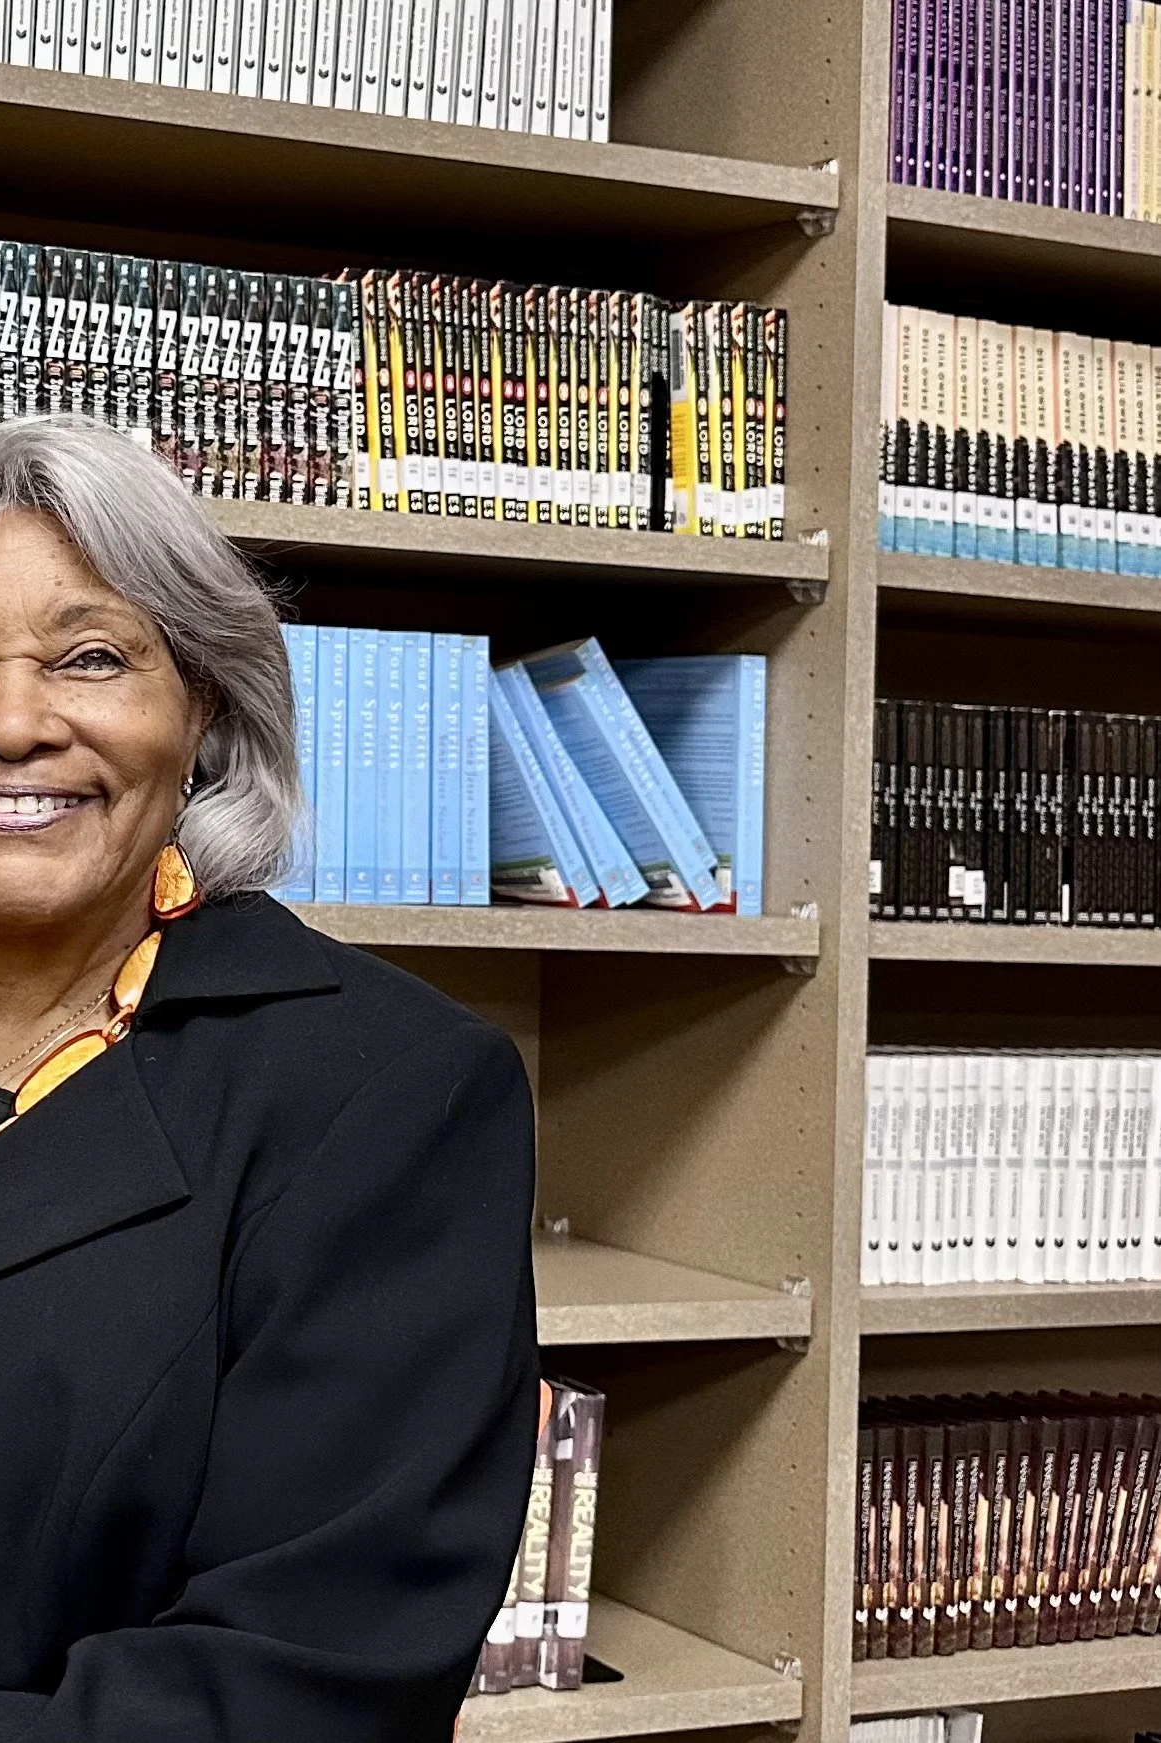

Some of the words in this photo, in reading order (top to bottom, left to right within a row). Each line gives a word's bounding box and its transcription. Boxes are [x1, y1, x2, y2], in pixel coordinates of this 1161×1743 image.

[333, 332, 351, 390] Z
[380, 393, 392, 436] LORD
[406, 394, 419, 438] LORD
[423, 397, 436, 440] LORD
[445, 398, 457, 442] LORD
[462, 401, 474, 444] LORD
[558, 406, 569, 450] LORD
[773, 426, 784, 468] LORD
[303, 640, 315, 685] Four
[333, 644, 347, 687] Four
[364, 644, 377, 687] Four
[449, 648, 461, 691] Four
[300, 696, 315, 764] Spirits
[330, 698, 345, 766] Spirits
[360, 698, 377, 766] Spirits
[445, 702, 459, 768] Spirits
[523, 1485, 551, 1596] REALITY
[568, 1489, 597, 1601] REALITY
